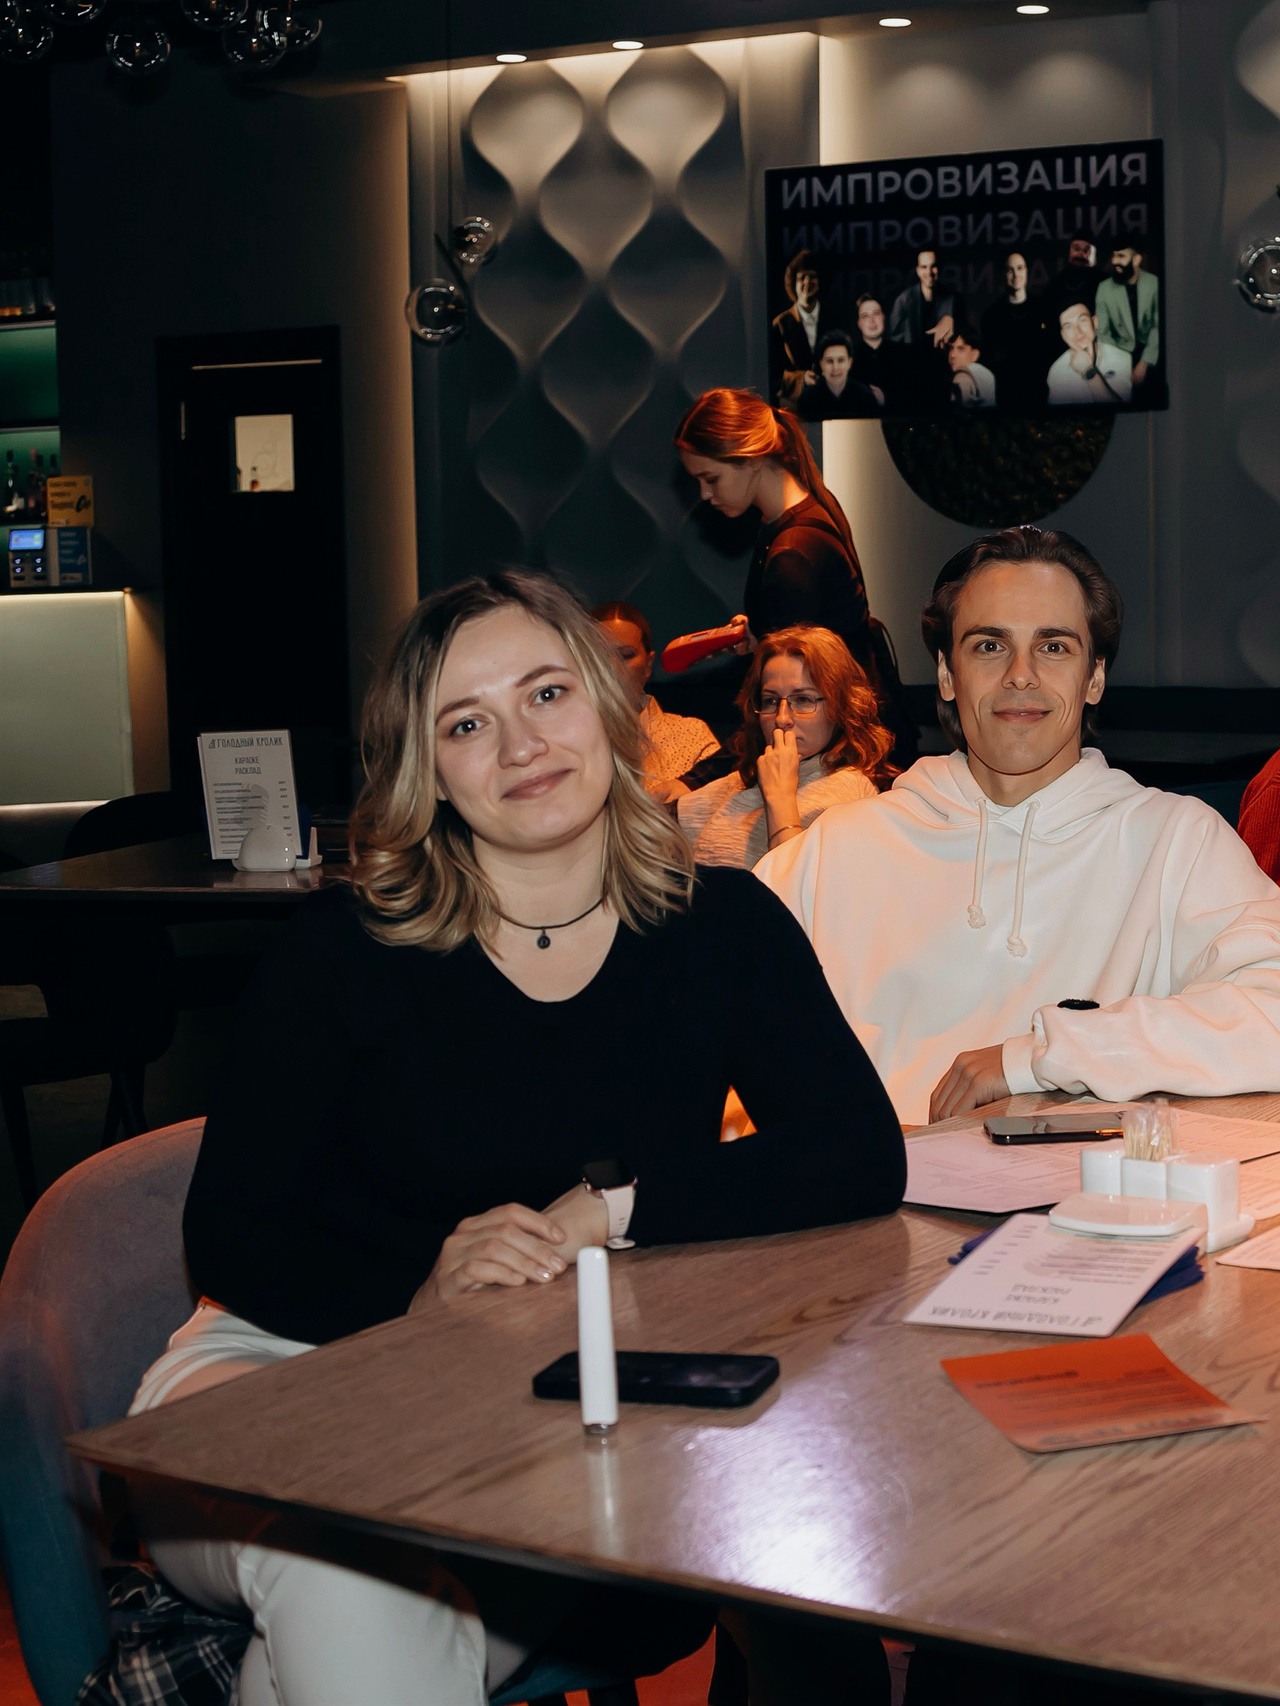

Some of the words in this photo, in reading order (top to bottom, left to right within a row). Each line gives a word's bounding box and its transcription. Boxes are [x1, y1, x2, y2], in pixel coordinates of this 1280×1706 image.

[781, 152, 1148, 210] ИМПРОВИЗАЦИЯ
[782, 203, 1148, 255] ИМПРОВИЗАЦИЯ
[217, 737, 254, 749] ГОЛОДНЫЙ
[256, 737, 283, 747] КРОЛИК
